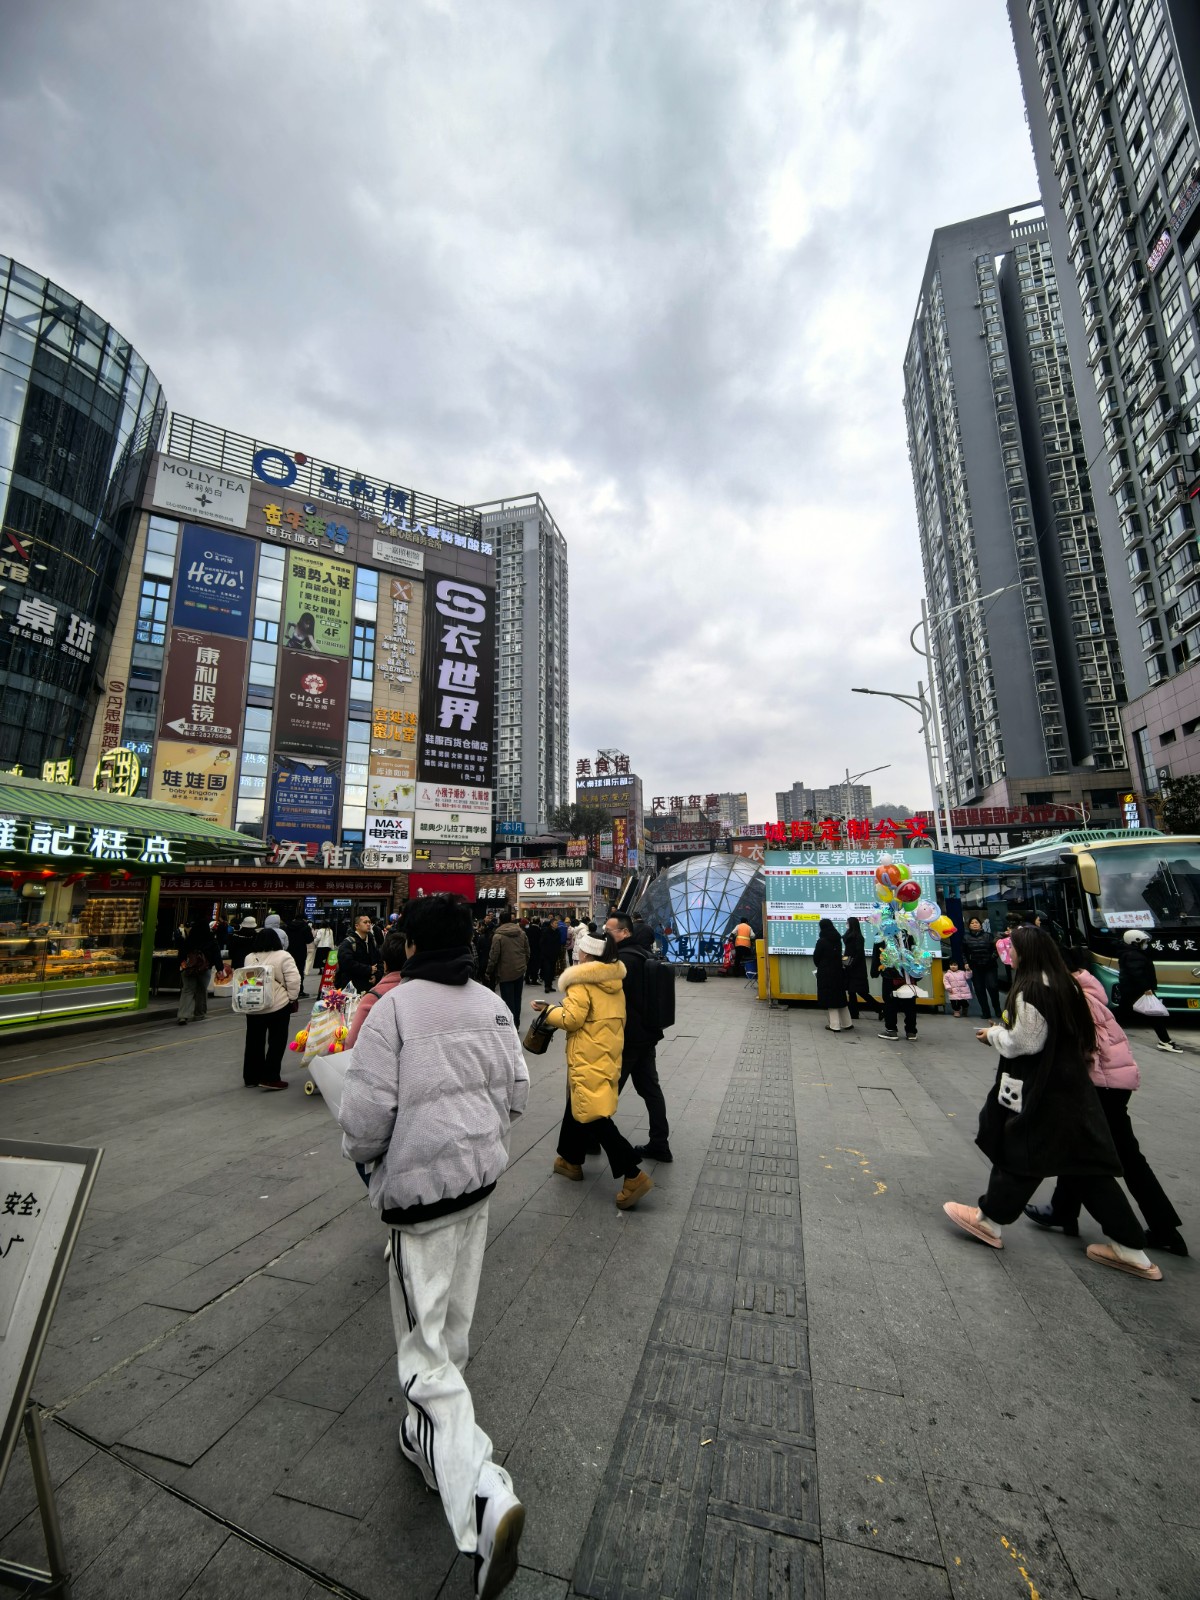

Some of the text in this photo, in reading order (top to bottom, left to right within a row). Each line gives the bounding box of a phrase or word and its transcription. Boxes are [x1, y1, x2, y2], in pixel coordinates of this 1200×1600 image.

[163, 462, 245, 493] MOLLY TEA
[185, 481, 222, 497] 茉莉奶白
[187, 561, 244, 590] Hello!
[293, 564, 351, 590] 强势入驻
[324, 627, 339, 638] 4F
[191, 646, 221, 723] 康利眼镜
[289, 693, 336, 706] CHAGEE
[161, 769, 227, 790] 娃娃国
[188, 789, 218, 797] kingdom
[375, 819, 403, 829] MAX
[764, 816, 929, 842] 城际定制公交
[369, 828, 408, 840] 电竞馆
[537, 877, 584, 887] 书亦烧仙草
[478, 887, 507, 899] 肯德基
